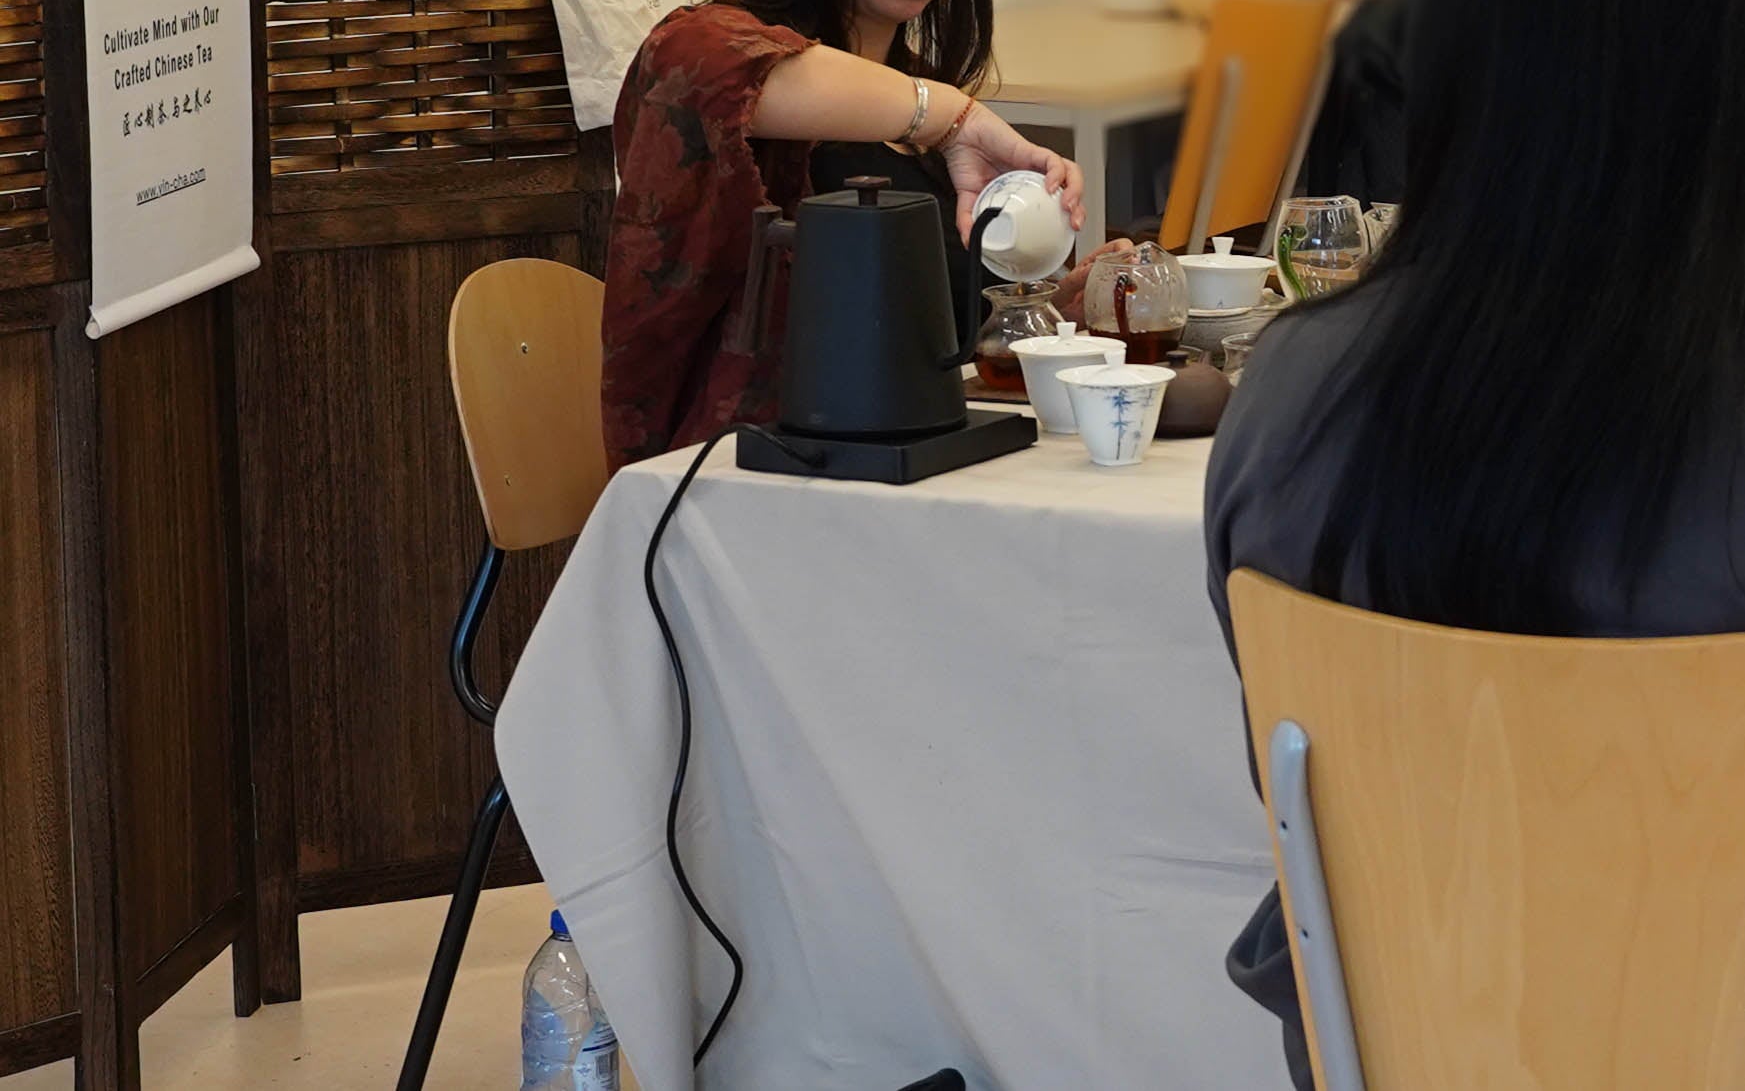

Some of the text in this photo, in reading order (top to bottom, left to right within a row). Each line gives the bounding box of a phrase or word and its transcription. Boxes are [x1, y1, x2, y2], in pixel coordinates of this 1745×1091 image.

[103, 5, 220, 55] Cultivate Mind with Our
[114, 44, 213, 90] Crafted Chinese Tea
[136, 167, 207, 203] www.yin-cha.com
